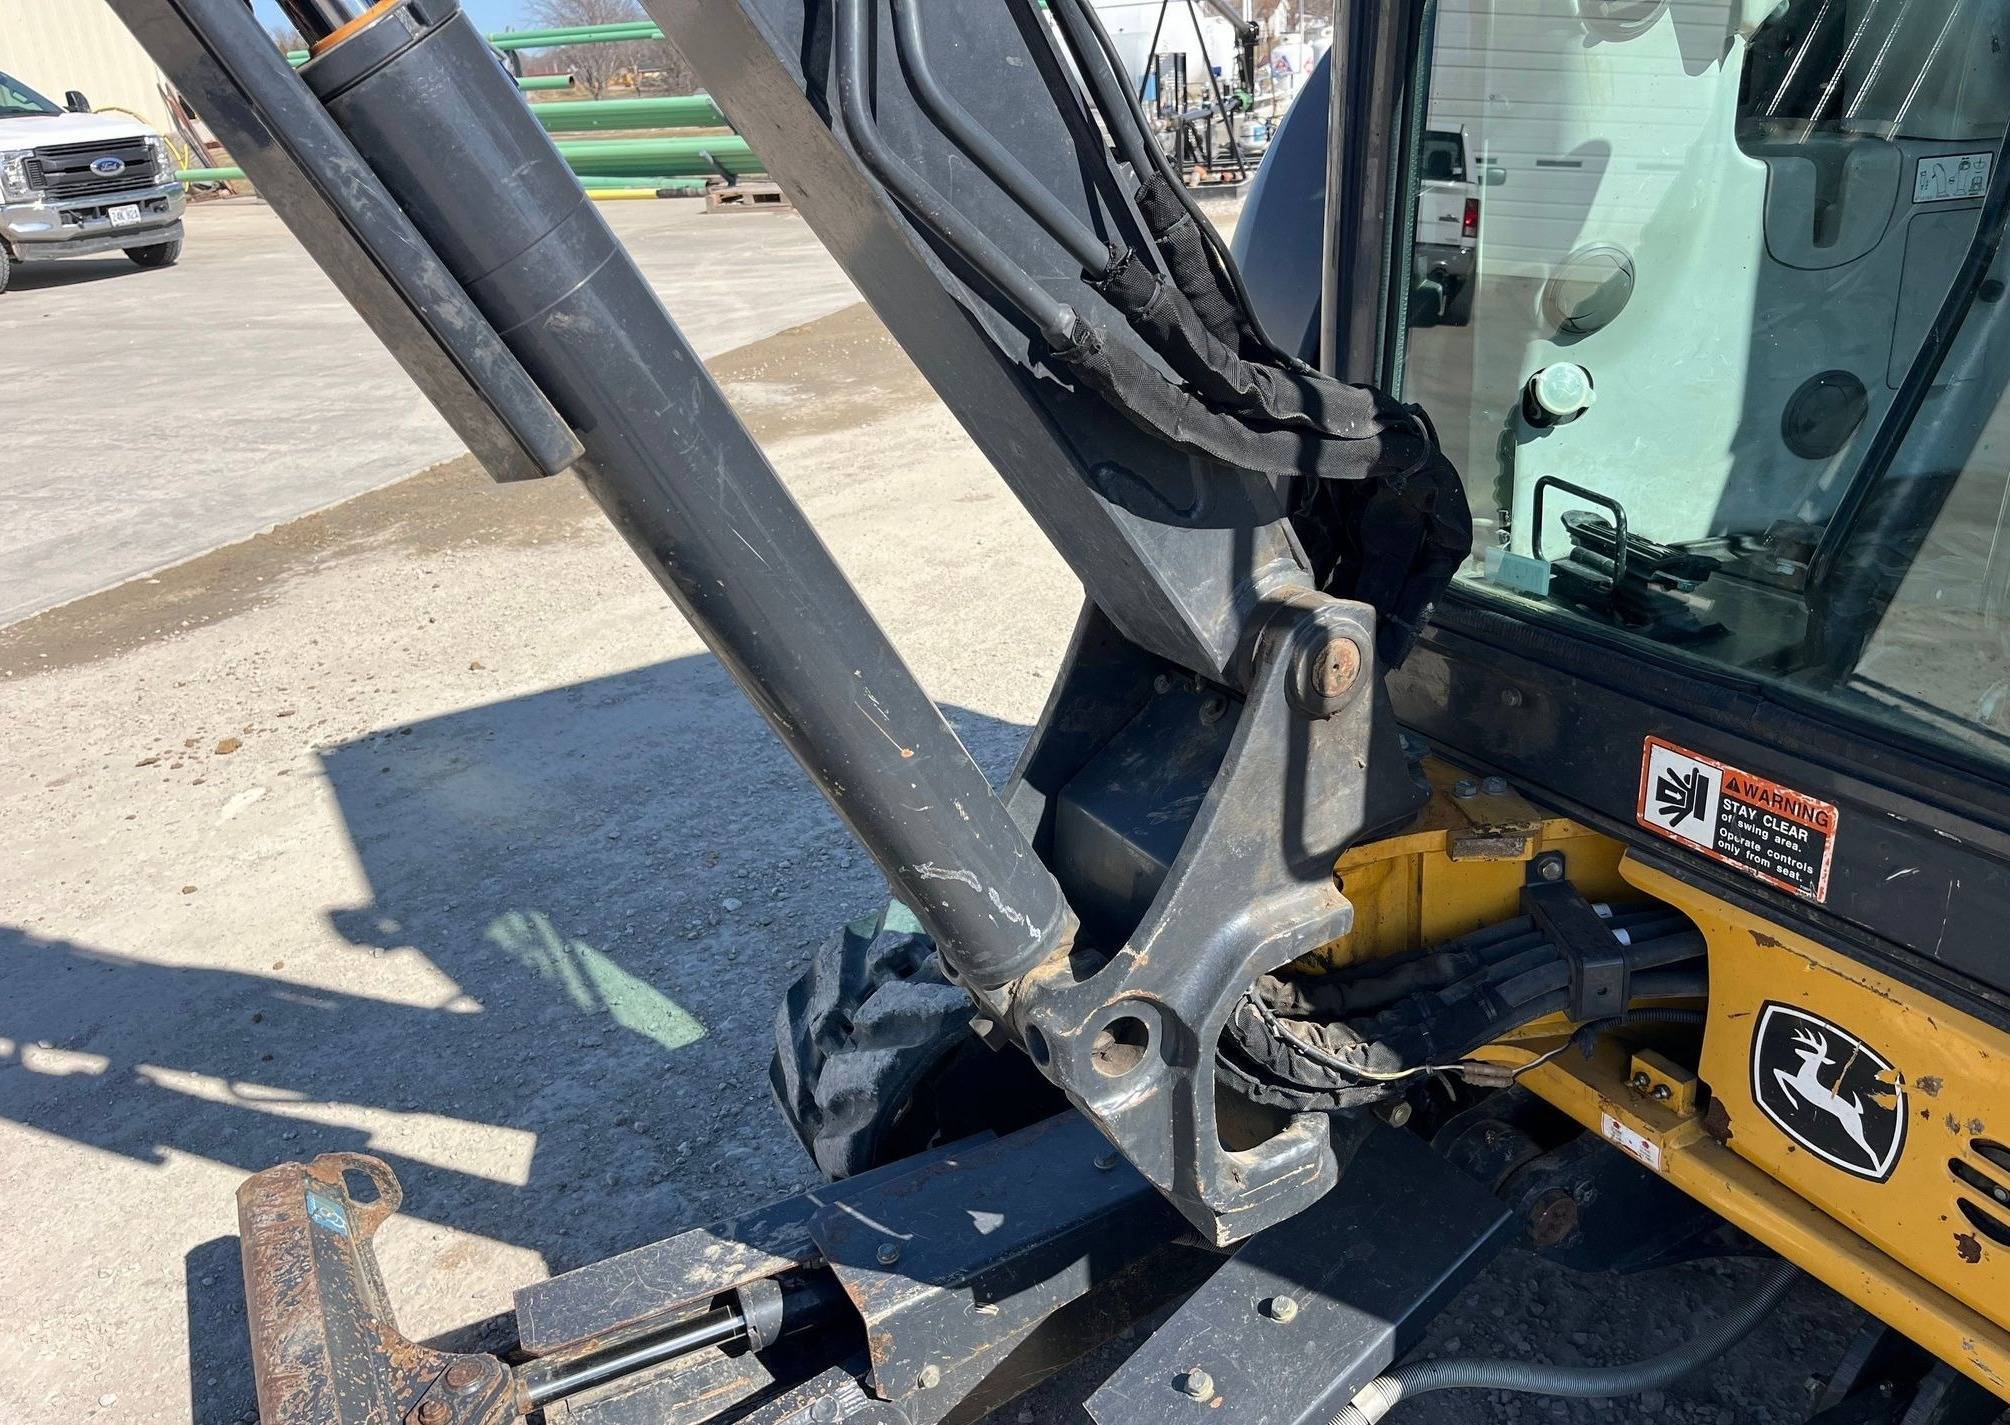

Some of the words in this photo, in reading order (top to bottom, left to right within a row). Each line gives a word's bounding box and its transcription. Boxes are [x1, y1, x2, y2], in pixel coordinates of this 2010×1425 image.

[1723, 798, 1757, 820] STAY
[1762, 814, 1808, 842] CLEAR
[1744, 781, 1829, 828] WARNING
[1719, 827, 1761, 852] Operate
[1766, 849, 1814, 874] controls
[1721, 813, 1734, 824] of
[1737, 820, 1769, 840] swing
[1774, 836, 1802, 852] area.
[1717, 840, 1741, 856] only
[1746, 850, 1771, 868] from
[1776, 865, 1803, 882] seat.
